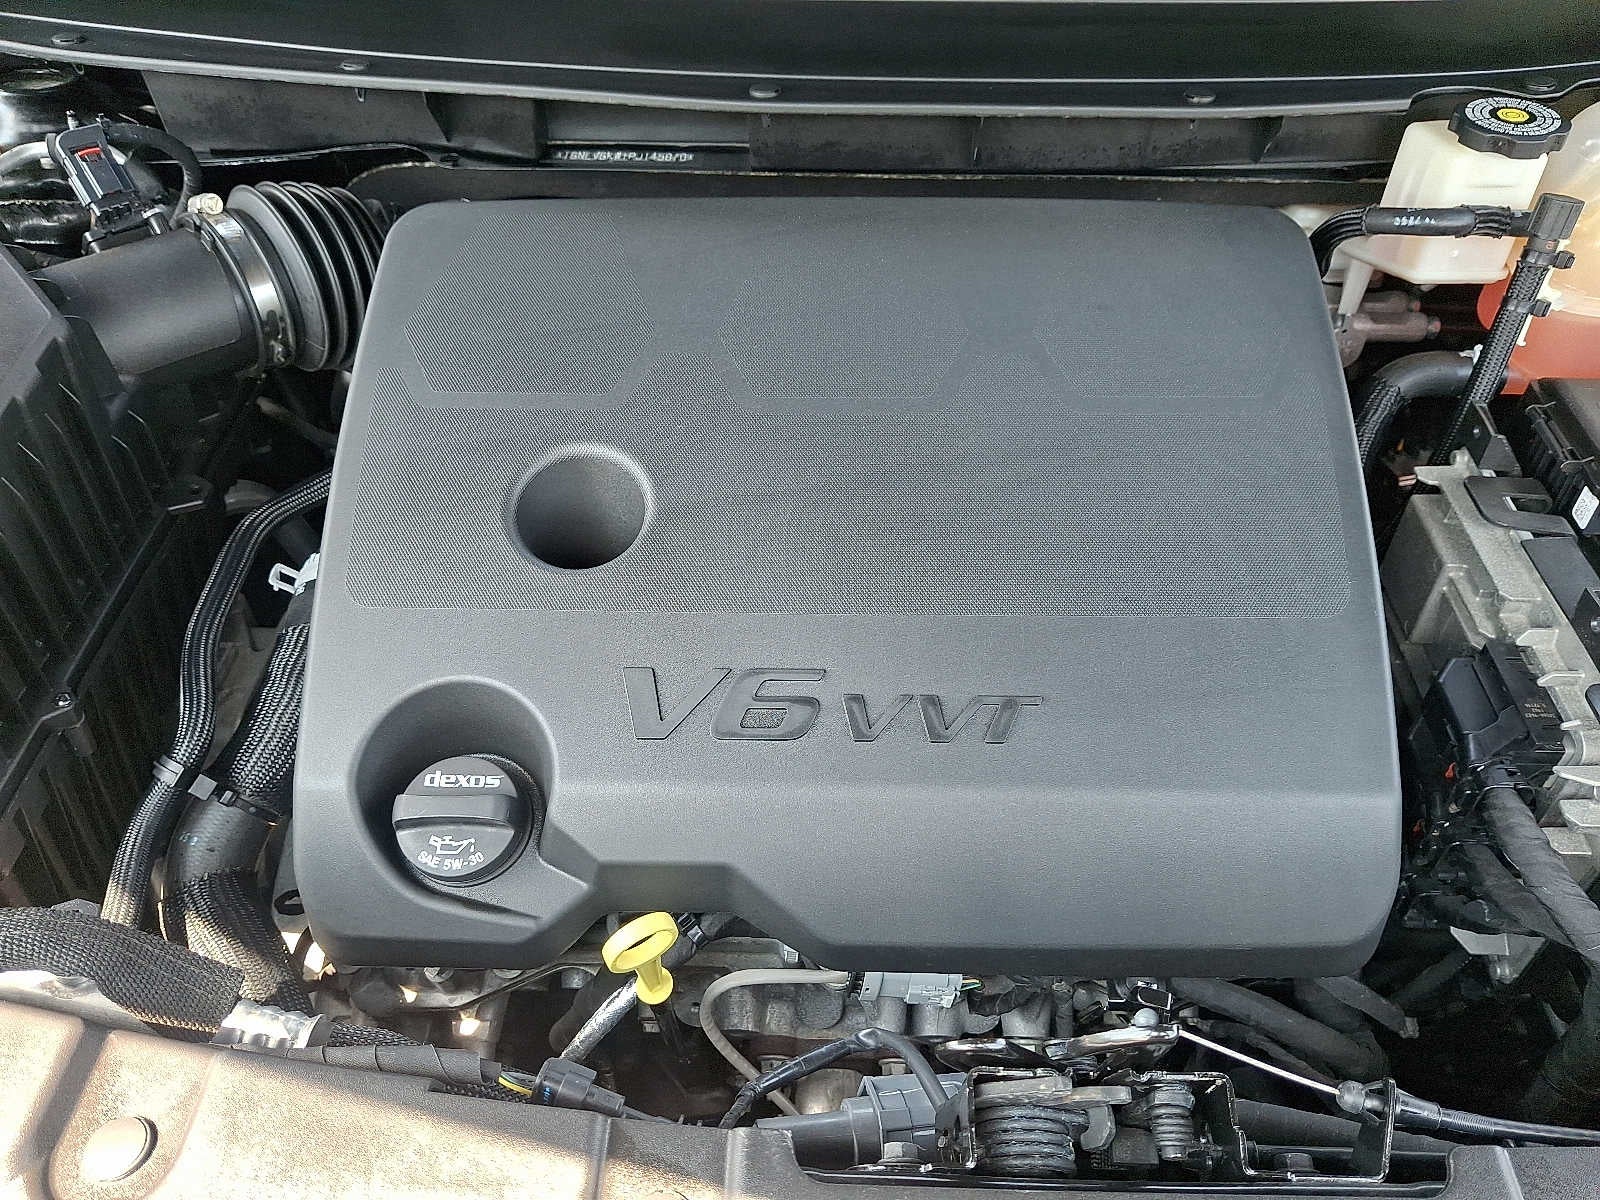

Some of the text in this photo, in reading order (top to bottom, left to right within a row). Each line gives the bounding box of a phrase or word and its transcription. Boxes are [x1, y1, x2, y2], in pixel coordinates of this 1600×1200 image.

[623, 666, 1044, 743] V6 VVT
[423, 770, 504, 788] dexos
[417, 850, 485, 870] SAE 5W-30
